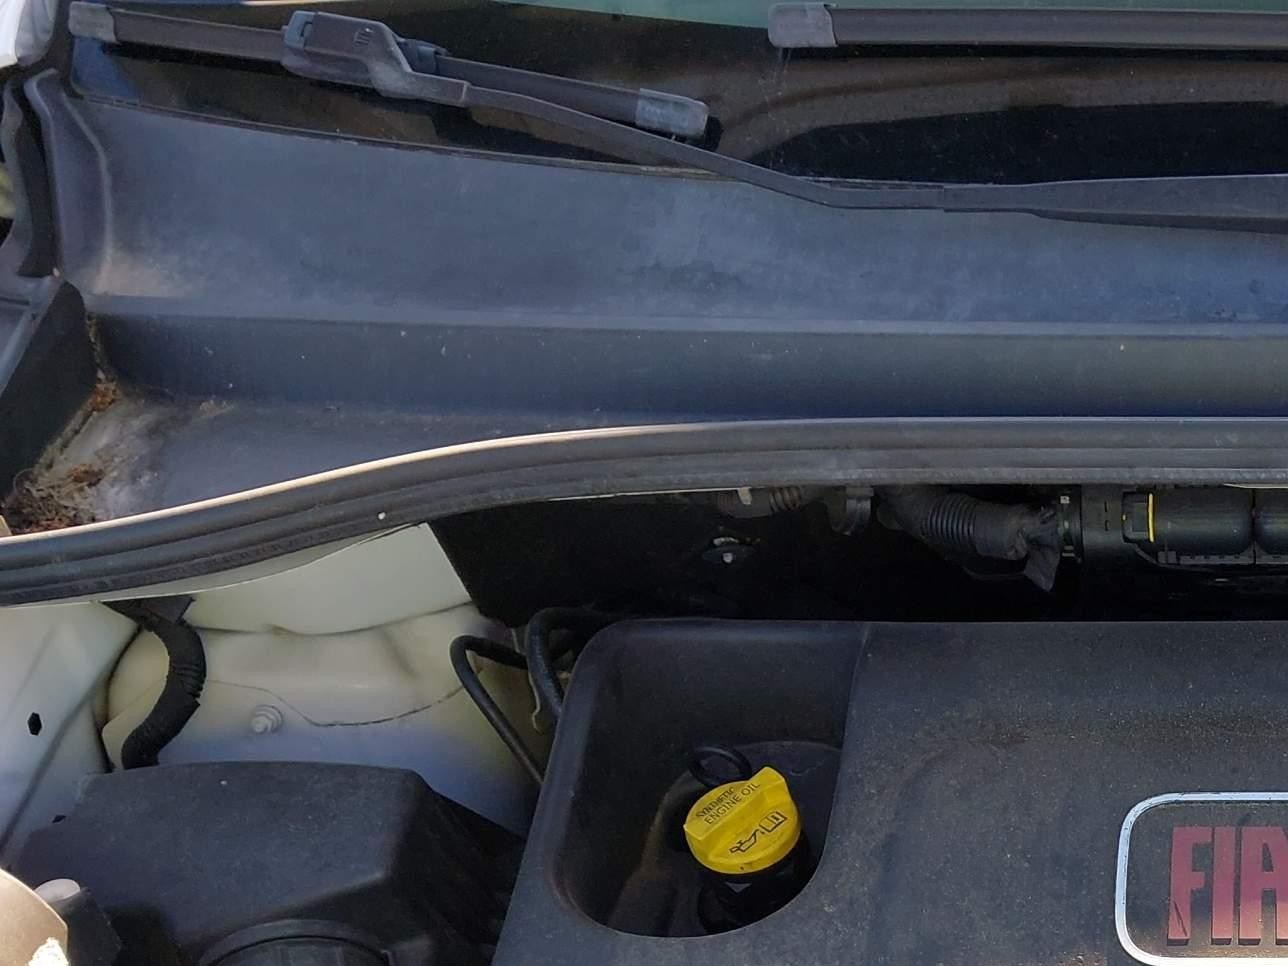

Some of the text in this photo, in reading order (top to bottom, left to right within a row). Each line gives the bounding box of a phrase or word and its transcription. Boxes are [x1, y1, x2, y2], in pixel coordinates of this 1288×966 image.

[695, 787, 737, 818] SYNTHETIC
[704, 782, 761, 825] ENGINE OIL
